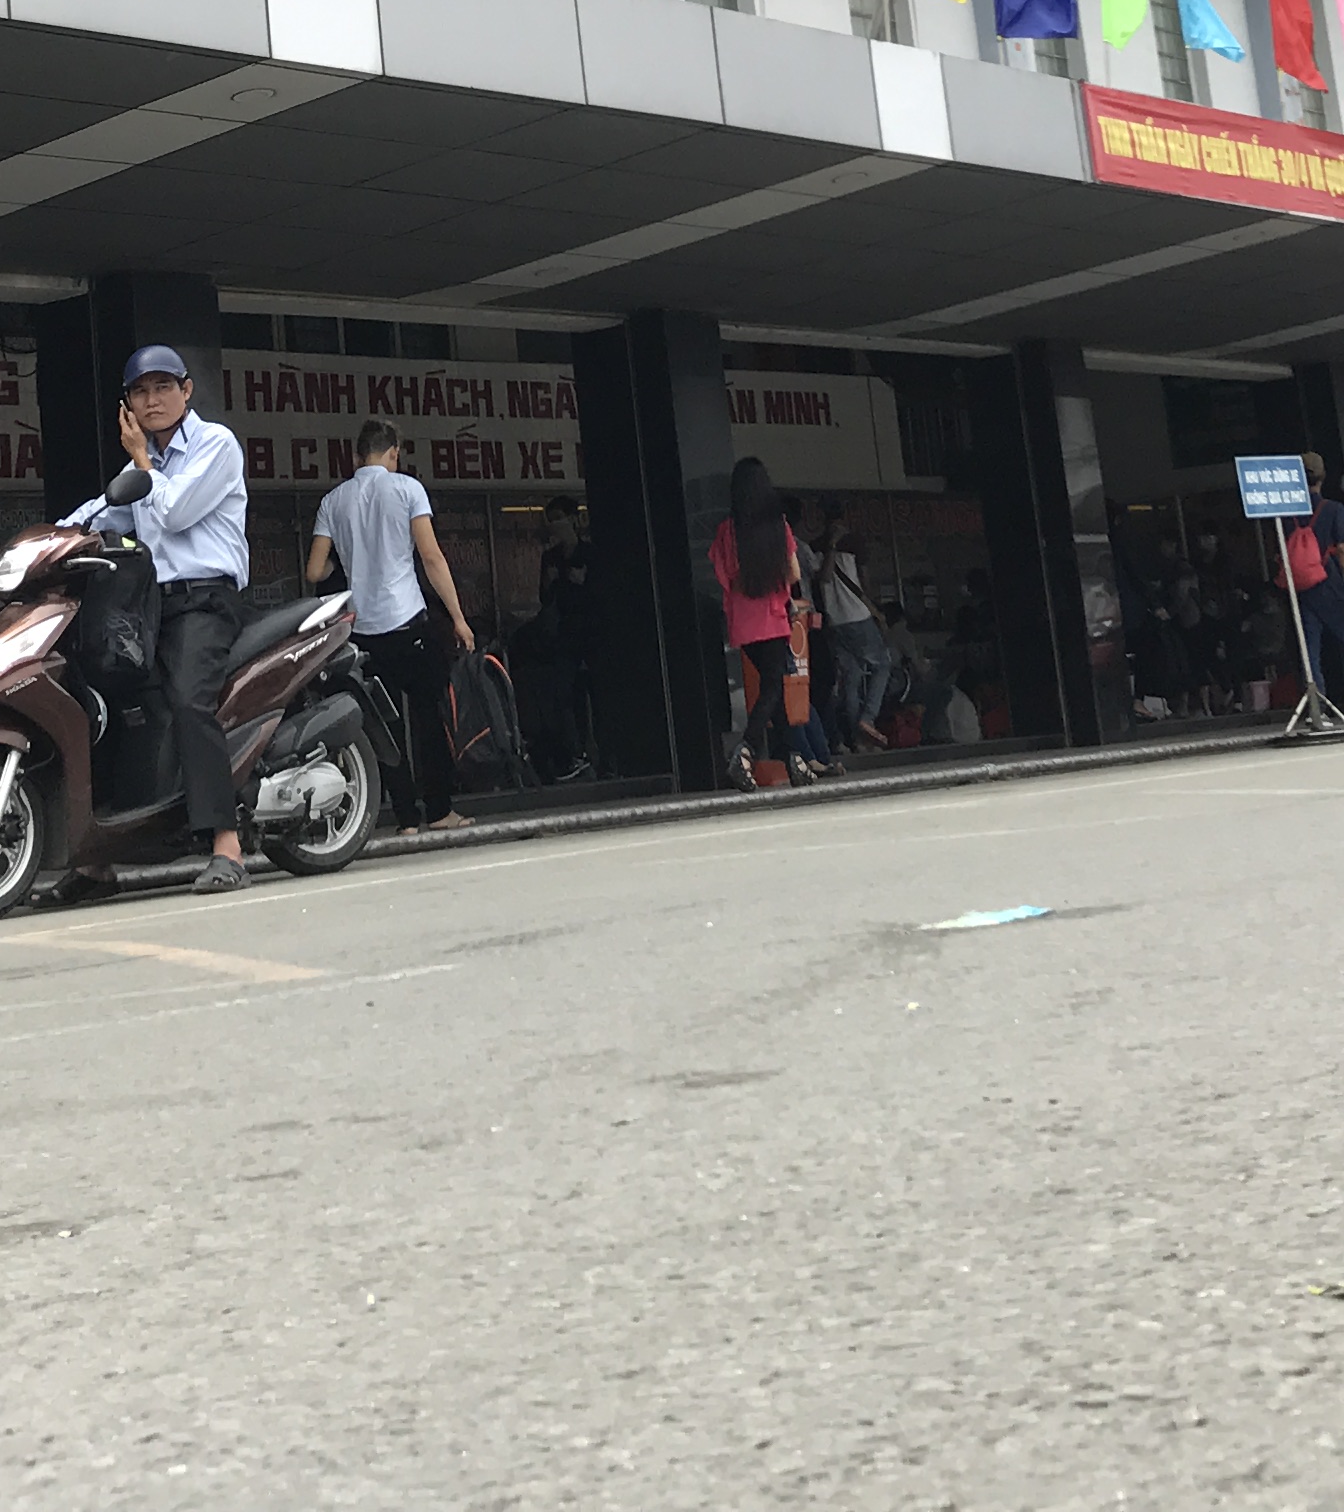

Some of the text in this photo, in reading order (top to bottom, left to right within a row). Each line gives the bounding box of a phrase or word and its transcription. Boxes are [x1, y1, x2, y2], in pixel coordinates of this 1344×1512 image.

[245, 363, 357, 413] HÀNH
[506, 374, 579, 420] NGÀ
[431, 423, 507, 480] BẾN
[519, 440, 565, 480] XE
